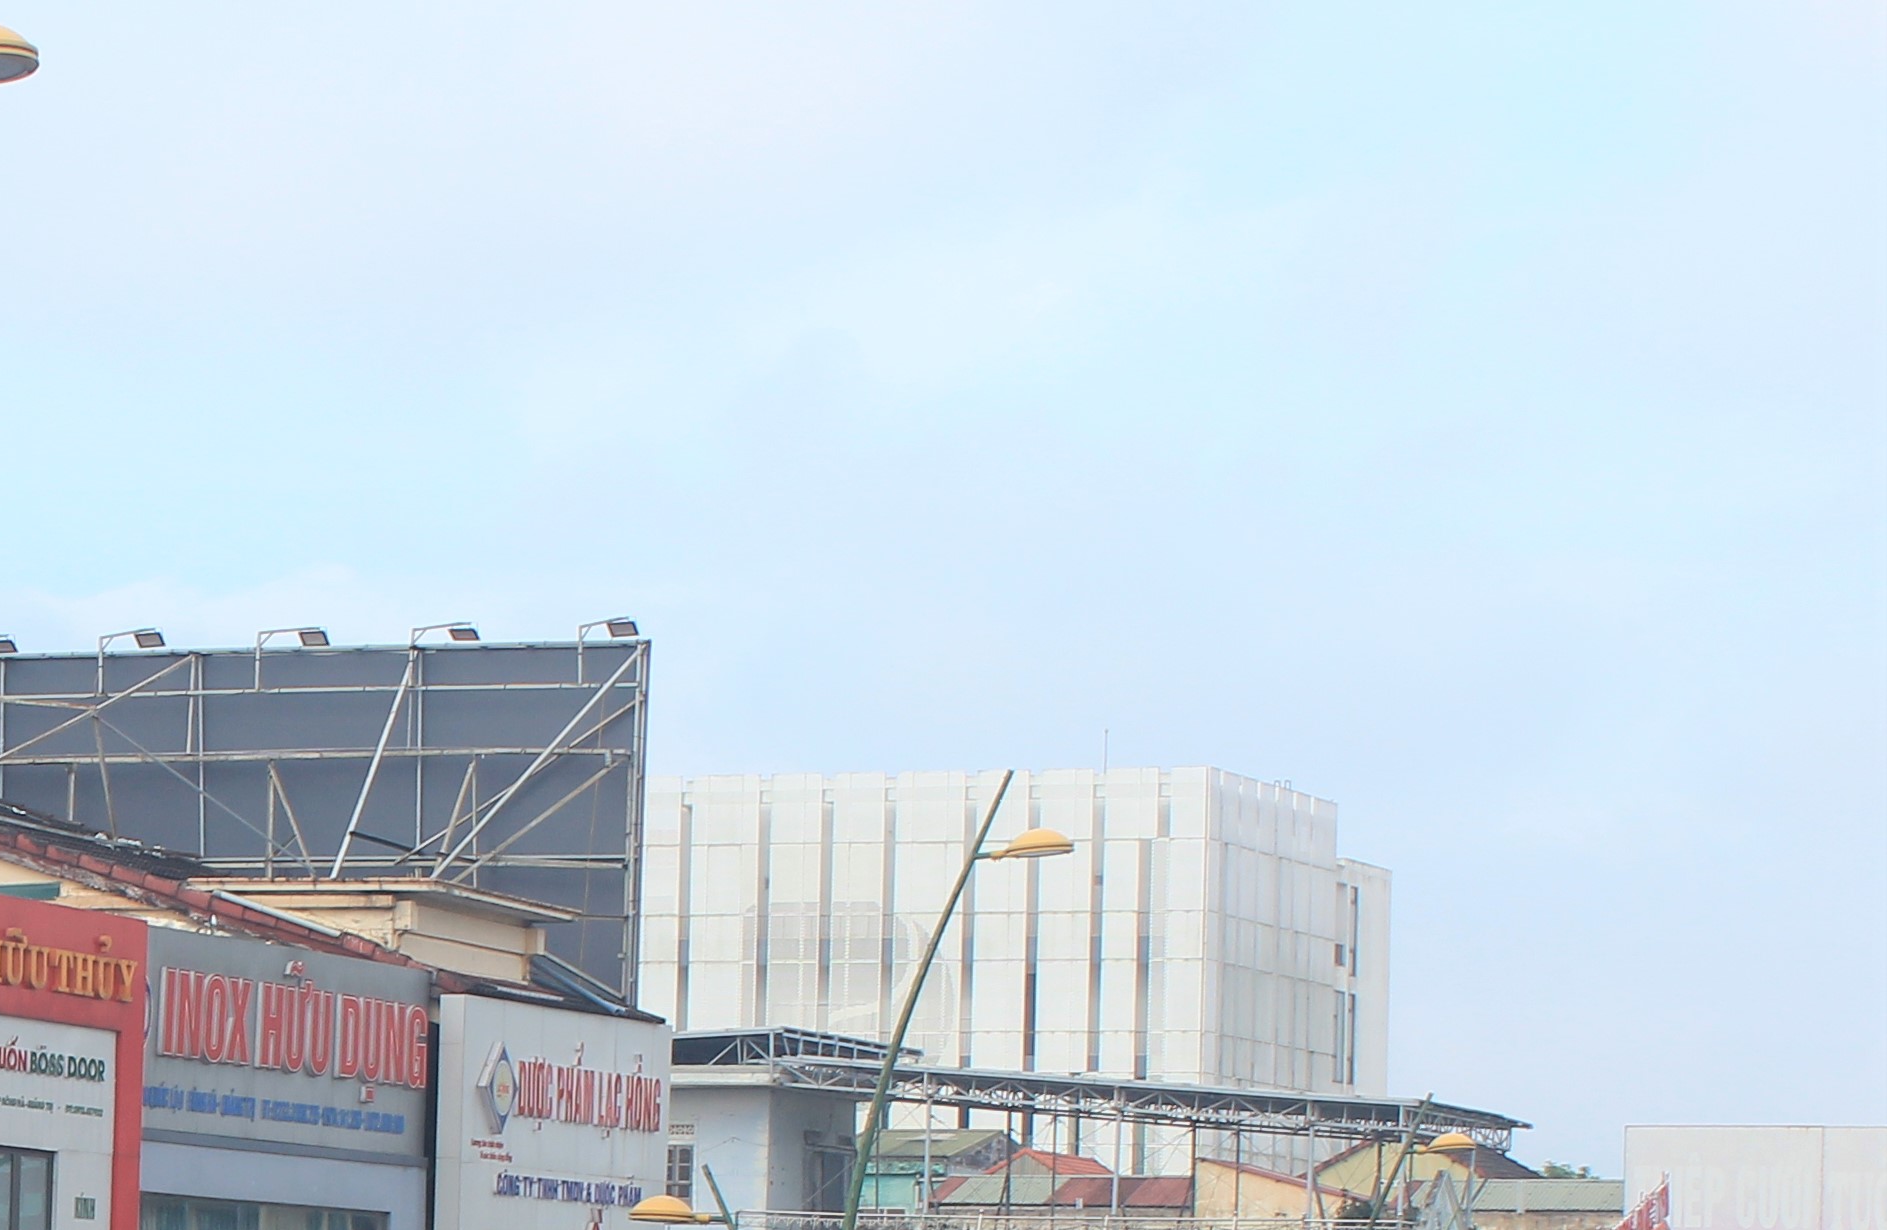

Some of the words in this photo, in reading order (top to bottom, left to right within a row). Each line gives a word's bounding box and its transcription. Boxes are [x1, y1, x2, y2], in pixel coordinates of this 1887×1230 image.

[66, 1056, 106, 1082] DOOR
[157, 965, 254, 1067] INOX
[254, 959, 334, 1077] HỮU
[334, 992, 430, 1104] DỤNG
[514, 1056, 553, 1132] DƯỢC
[554, 1041, 595, 1125] PHẨM
[596, 1071, 621, 1140] LẠC
[621, 1054, 661, 1133] HỒNG
